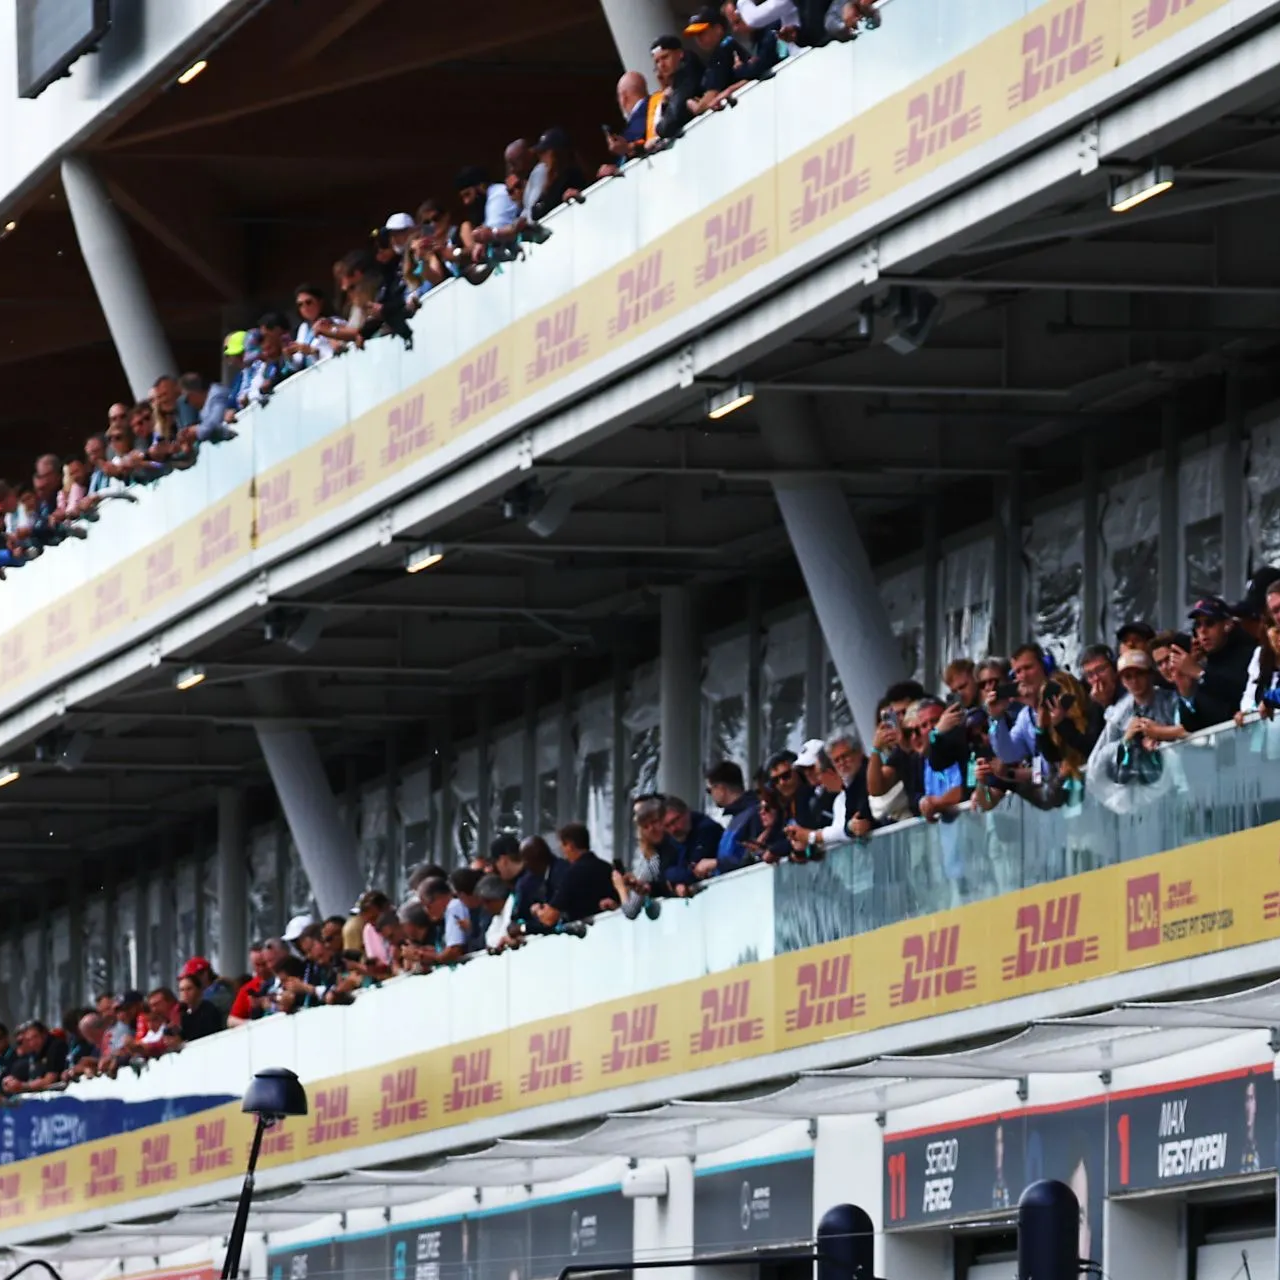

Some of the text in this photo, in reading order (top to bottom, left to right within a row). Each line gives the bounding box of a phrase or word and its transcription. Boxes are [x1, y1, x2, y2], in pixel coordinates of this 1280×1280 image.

[1022, 0, 1087, 102] DHL
[907, 70, 968, 167] DHL
[802, 134, 859, 227] DHL
[705, 194, 757, 283] DHL
[617, 250, 665, 333] DHL
[901, 925, 965, 1004] DHL
[1015, 893, 1087, 980] DHL
[700, 980, 753, 1053] DHL
[796, 954, 855, 1031] DHL
[528, 1027, 573, 1092] DHL
[611, 1004, 660, 1074] DHL
[452, 1048, 494, 1111] DHL
[1117, 1113, 1130, 1185] 1
[1158, 1099, 1188, 1137] MAX
[925, 1138, 959, 1175] SERGIO
[1158, 1132, 1228, 1178] VERSTAPPEN
[923, 1177, 954, 1212] PEREZ
